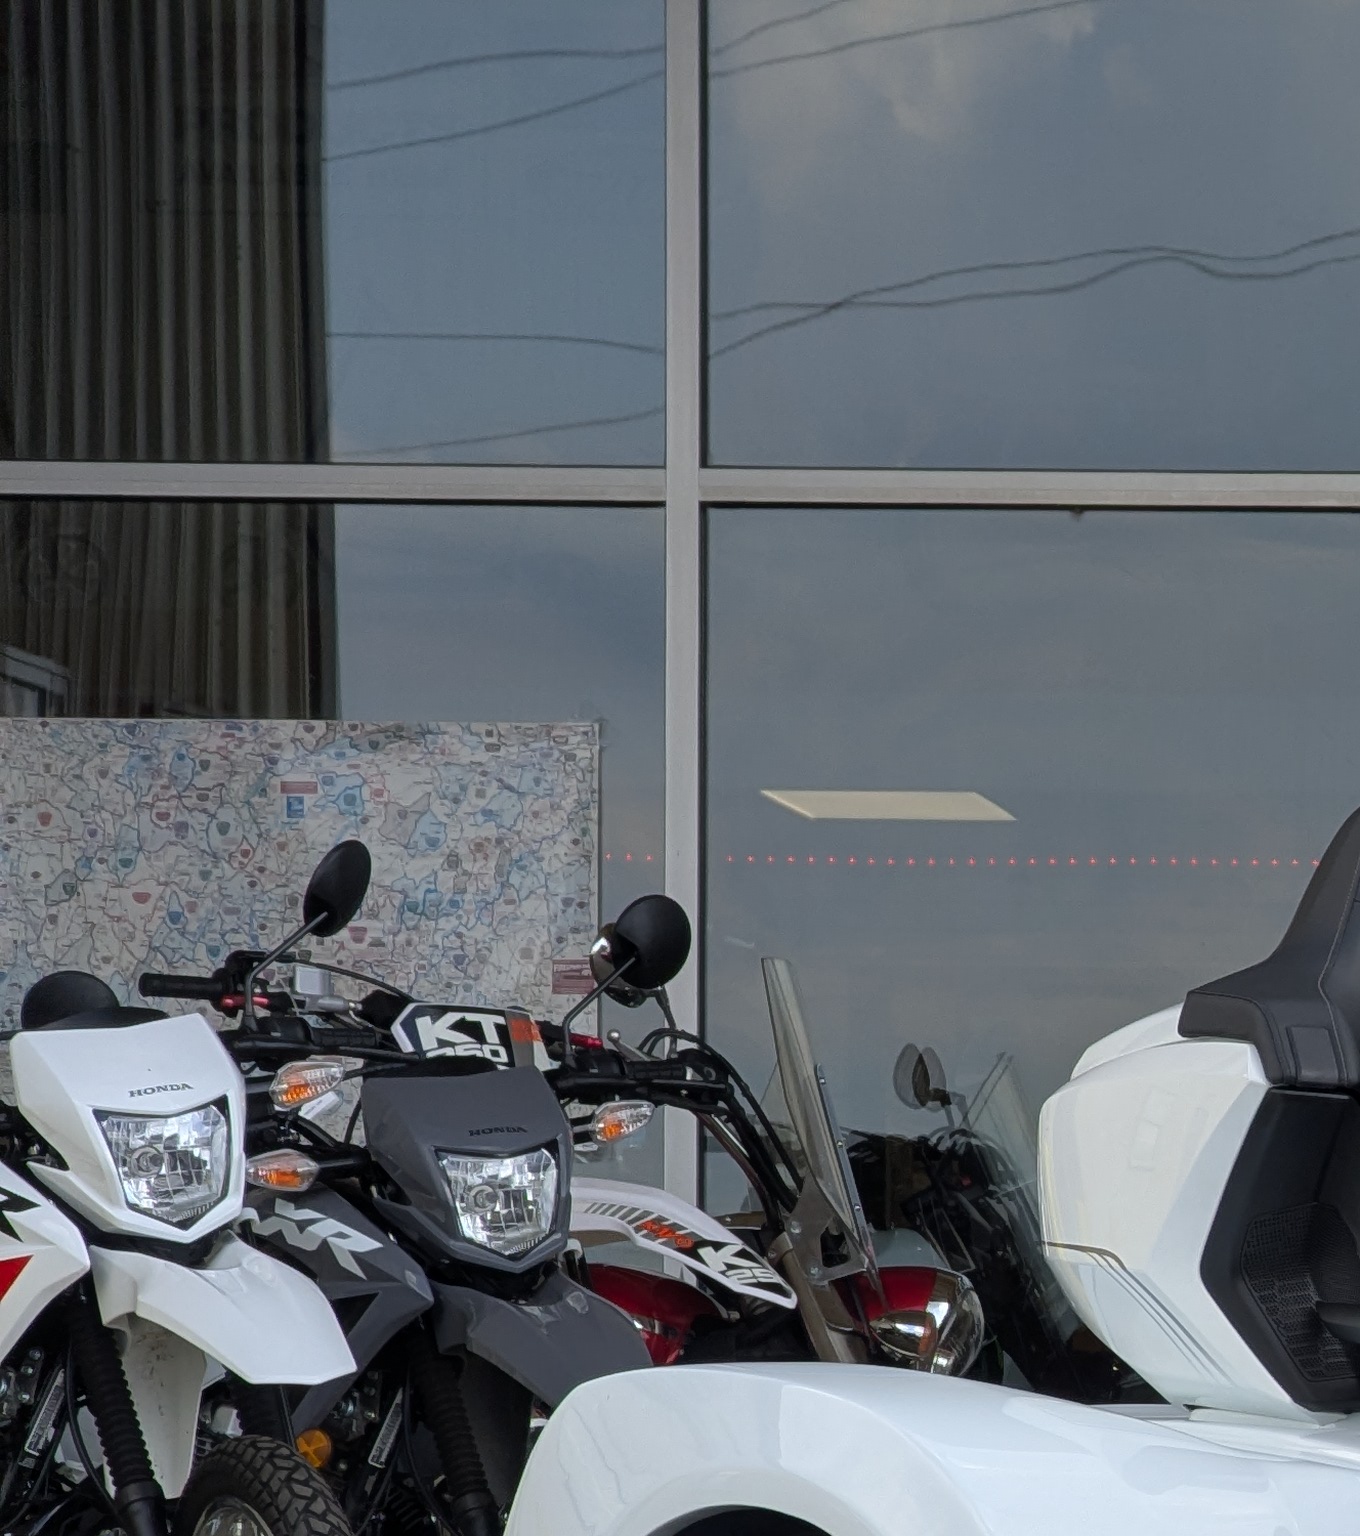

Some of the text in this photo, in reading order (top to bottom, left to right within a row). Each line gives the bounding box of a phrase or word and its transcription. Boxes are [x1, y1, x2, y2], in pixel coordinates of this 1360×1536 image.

[414, 1011, 507, 1051] KT
[128, 1082, 195, 1098] HONDA
[468, 1126, 528, 1137] HONDA
